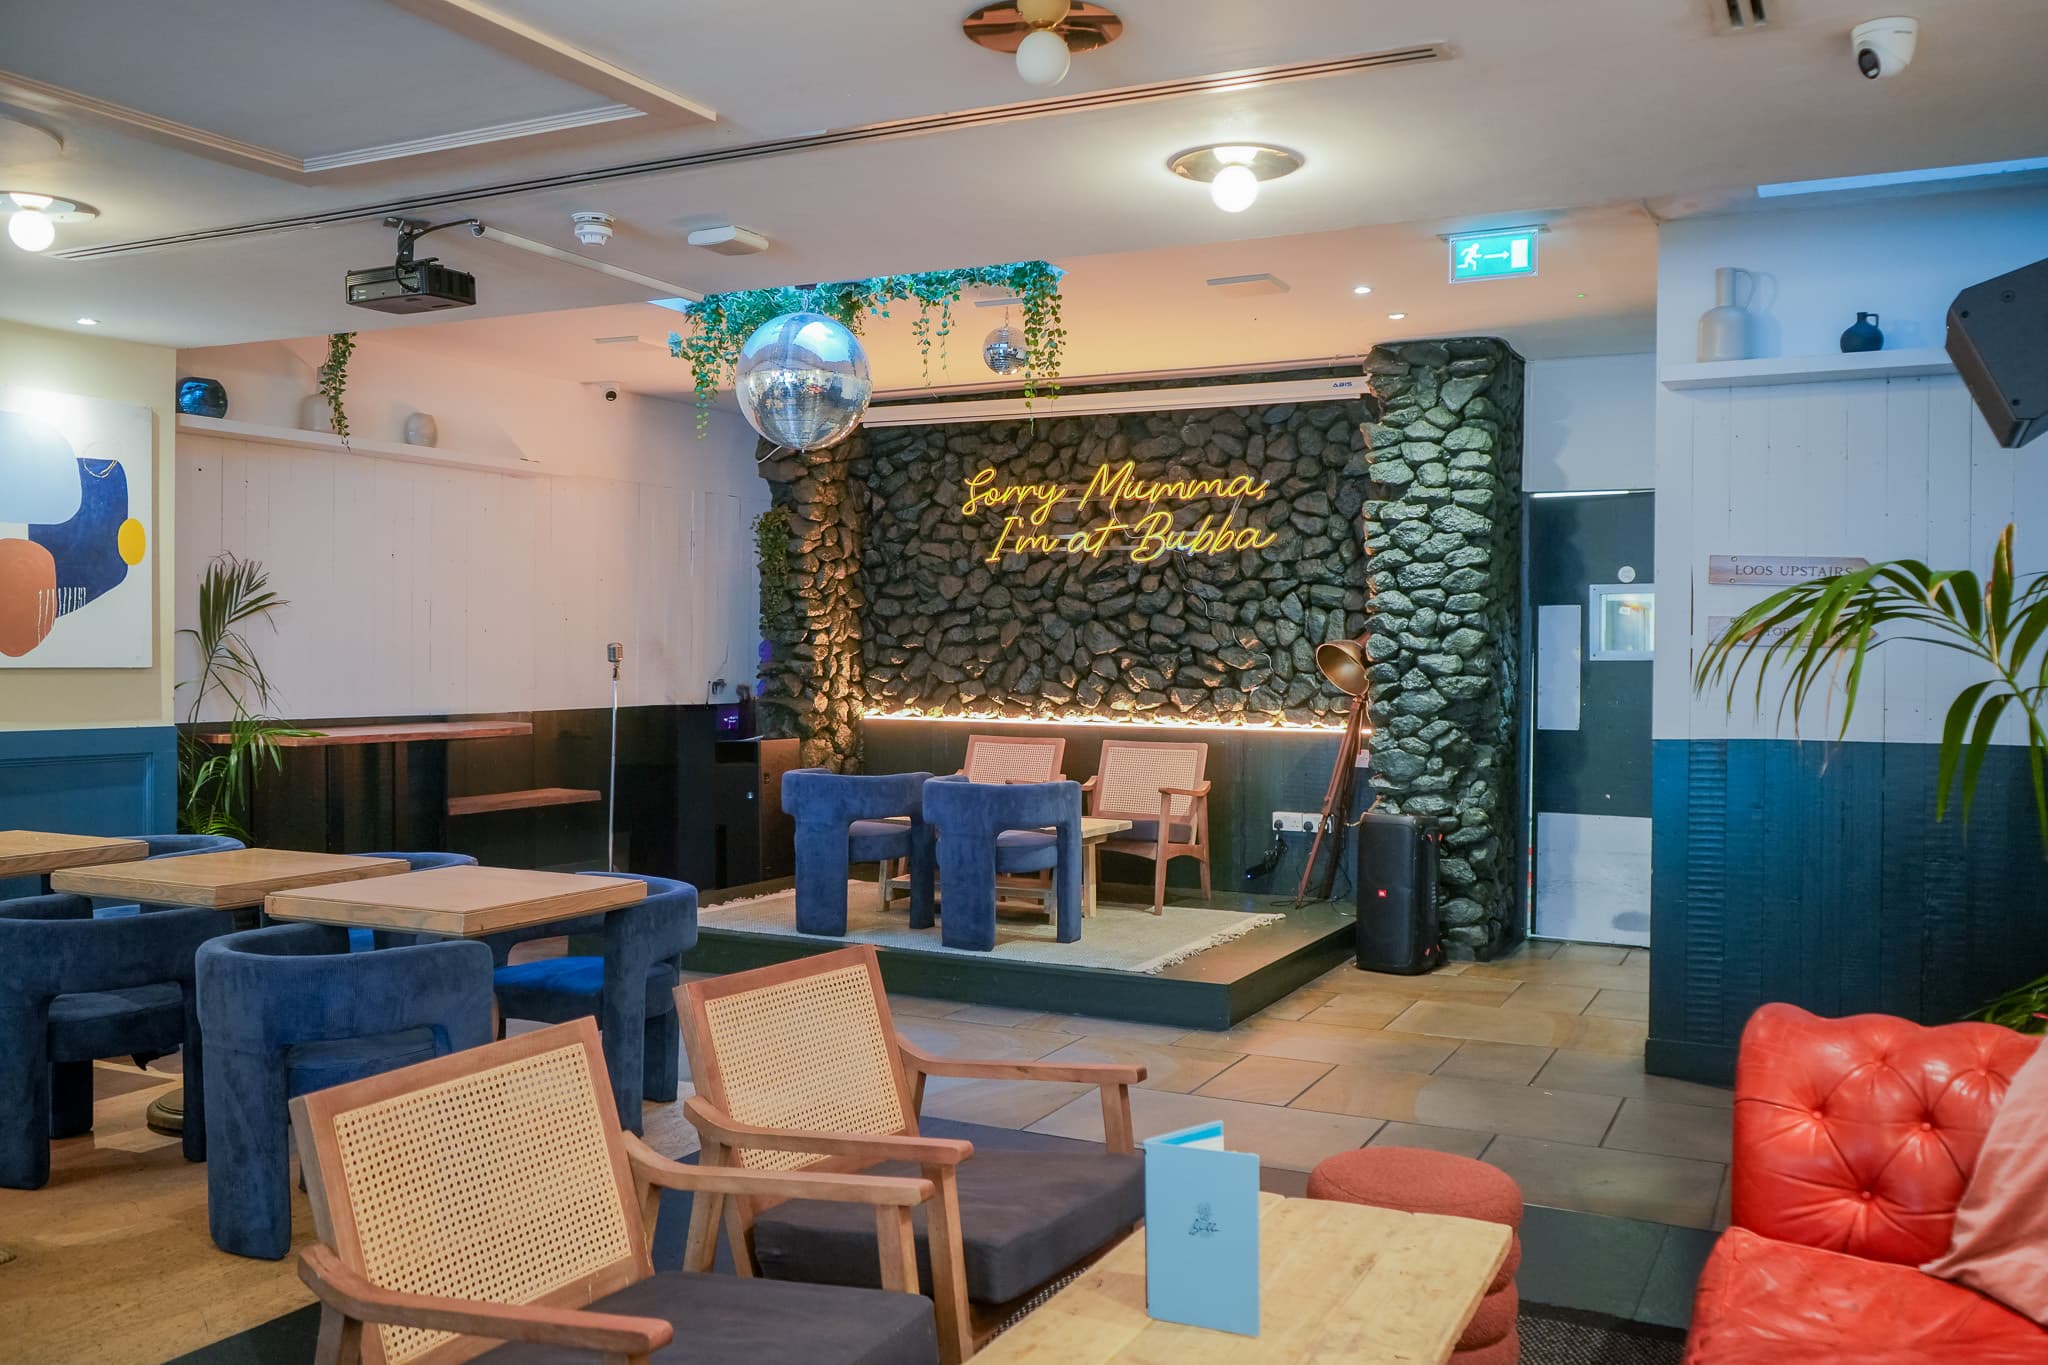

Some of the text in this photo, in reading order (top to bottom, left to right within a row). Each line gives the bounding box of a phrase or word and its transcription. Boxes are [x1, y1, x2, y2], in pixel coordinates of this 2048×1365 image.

[961, 460, 1271, 526] Sorry Mumma,
[984, 510, 1278, 563] I'm at Bubba
[1735, 565, 1854, 577] LOOS UPSTAIRS
